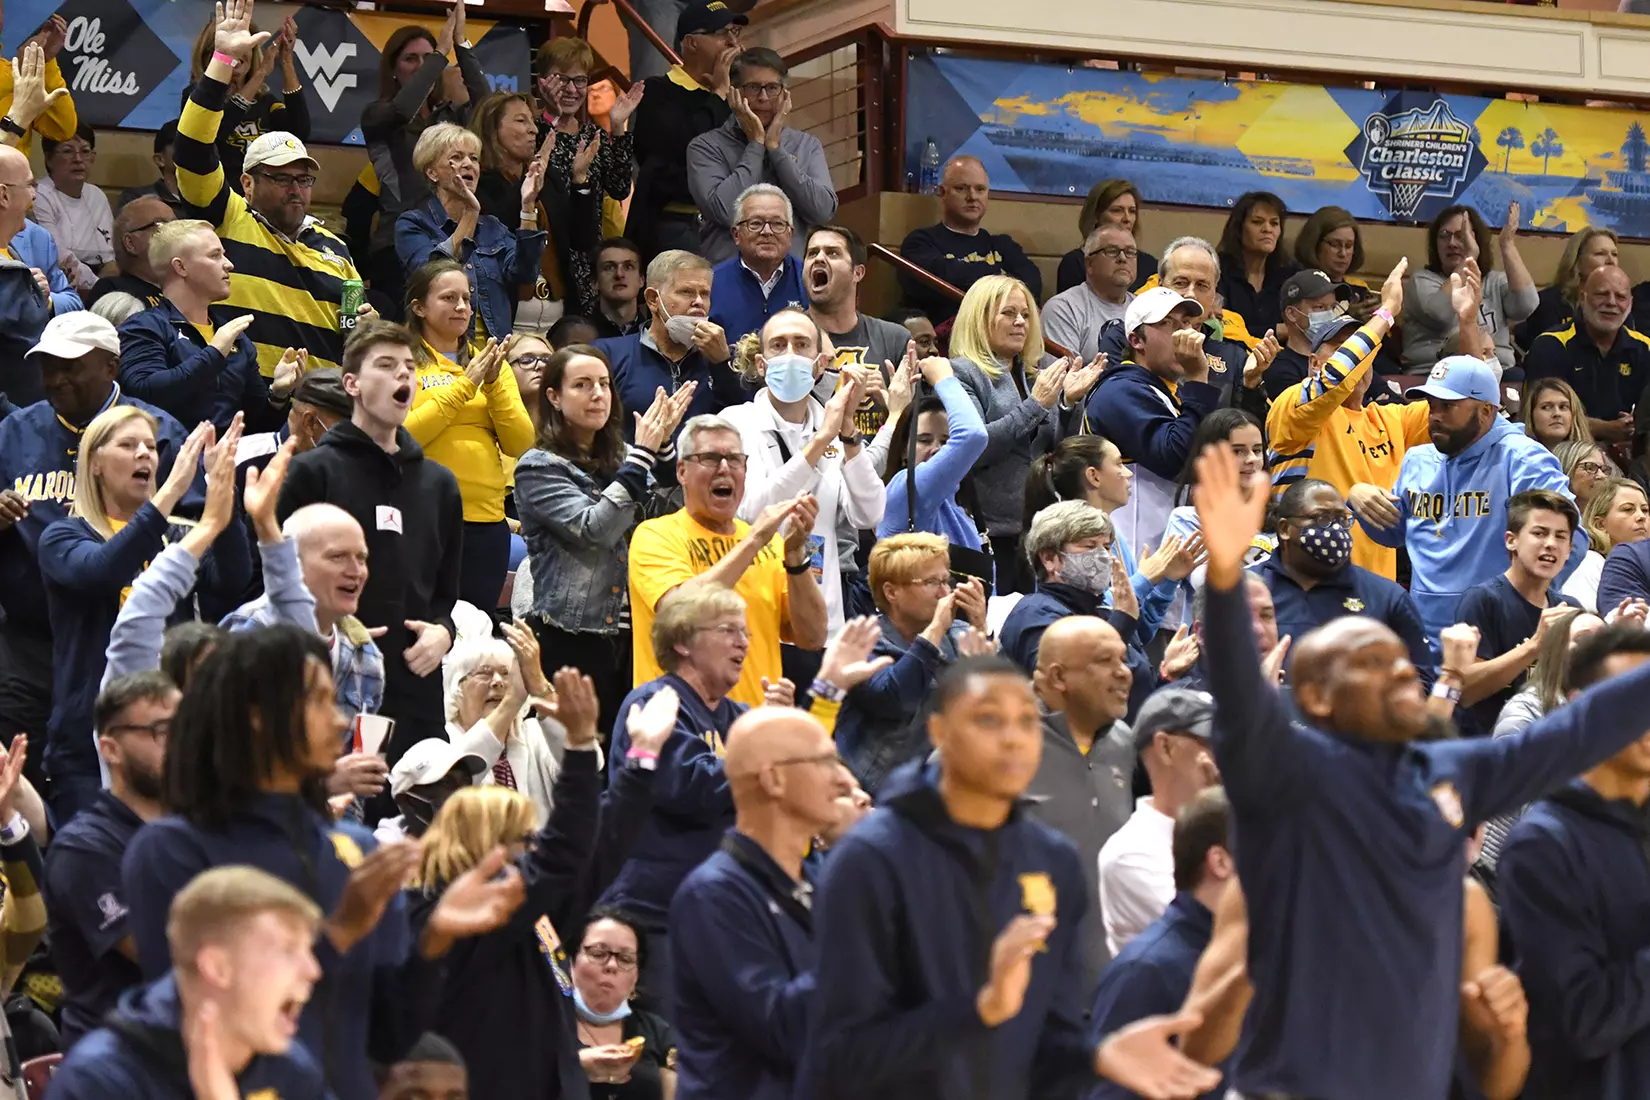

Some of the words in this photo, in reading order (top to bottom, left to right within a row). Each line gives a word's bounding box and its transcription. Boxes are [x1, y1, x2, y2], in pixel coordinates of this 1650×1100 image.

[64, 16, 106, 54] Ole
[71, 55, 140, 95] Miss
[1368, 146, 1464, 168] Charleston
[1384, 139, 1425, 149] SHRINERS
[1425, 141, 1467, 152] CHILDREN'S
[1381, 163, 1445, 182] Classic
[1407, 488, 1491, 526] MARQETTE
